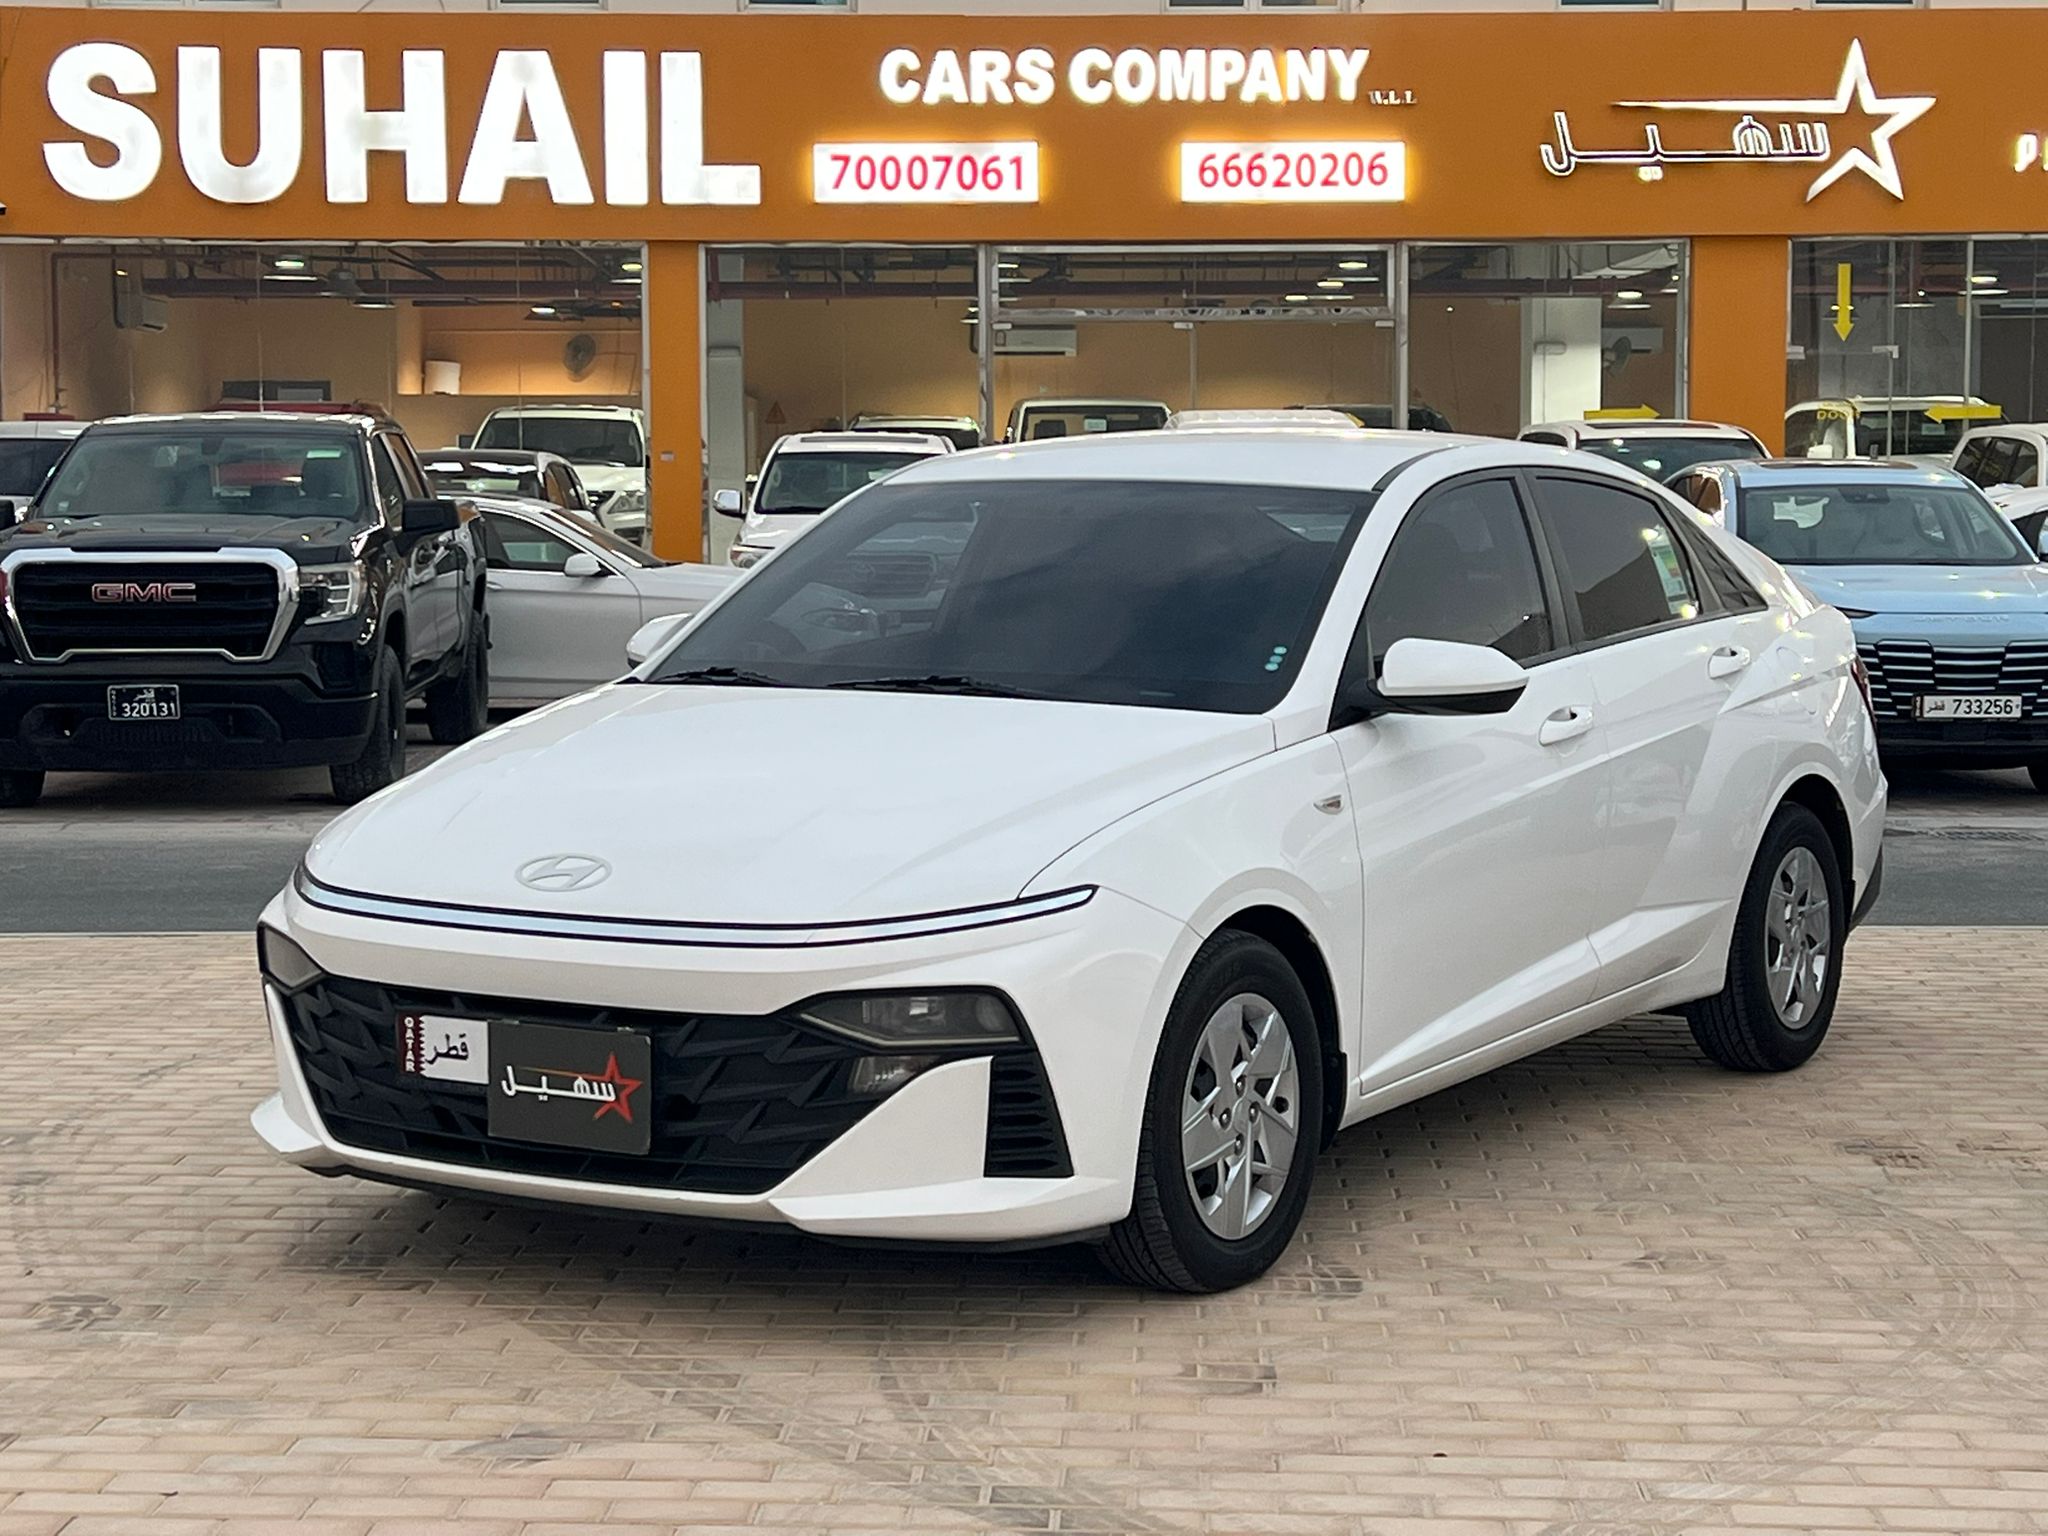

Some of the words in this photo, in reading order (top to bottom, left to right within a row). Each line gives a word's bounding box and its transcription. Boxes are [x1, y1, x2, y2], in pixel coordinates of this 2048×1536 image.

[880, 48, 1055, 104] CARS
[1068, 47, 1370, 104] COMPANY
[42, 42, 761, 205] SUHAIL
[1539, 111, 1831, 181] سهيل
[829, 155, 1025, 191] 70007061
[1198, 152, 1390, 188] 66620206
[91, 583, 197, 602] GMC
[121, 702, 177, 717] 320131
[1952, 699, 2014, 715] 733256
[404, 1017, 416, 1073] QATAR
[425, 1033, 470, 1065] قطر
[501, 1065, 617, 1102] سهيل
